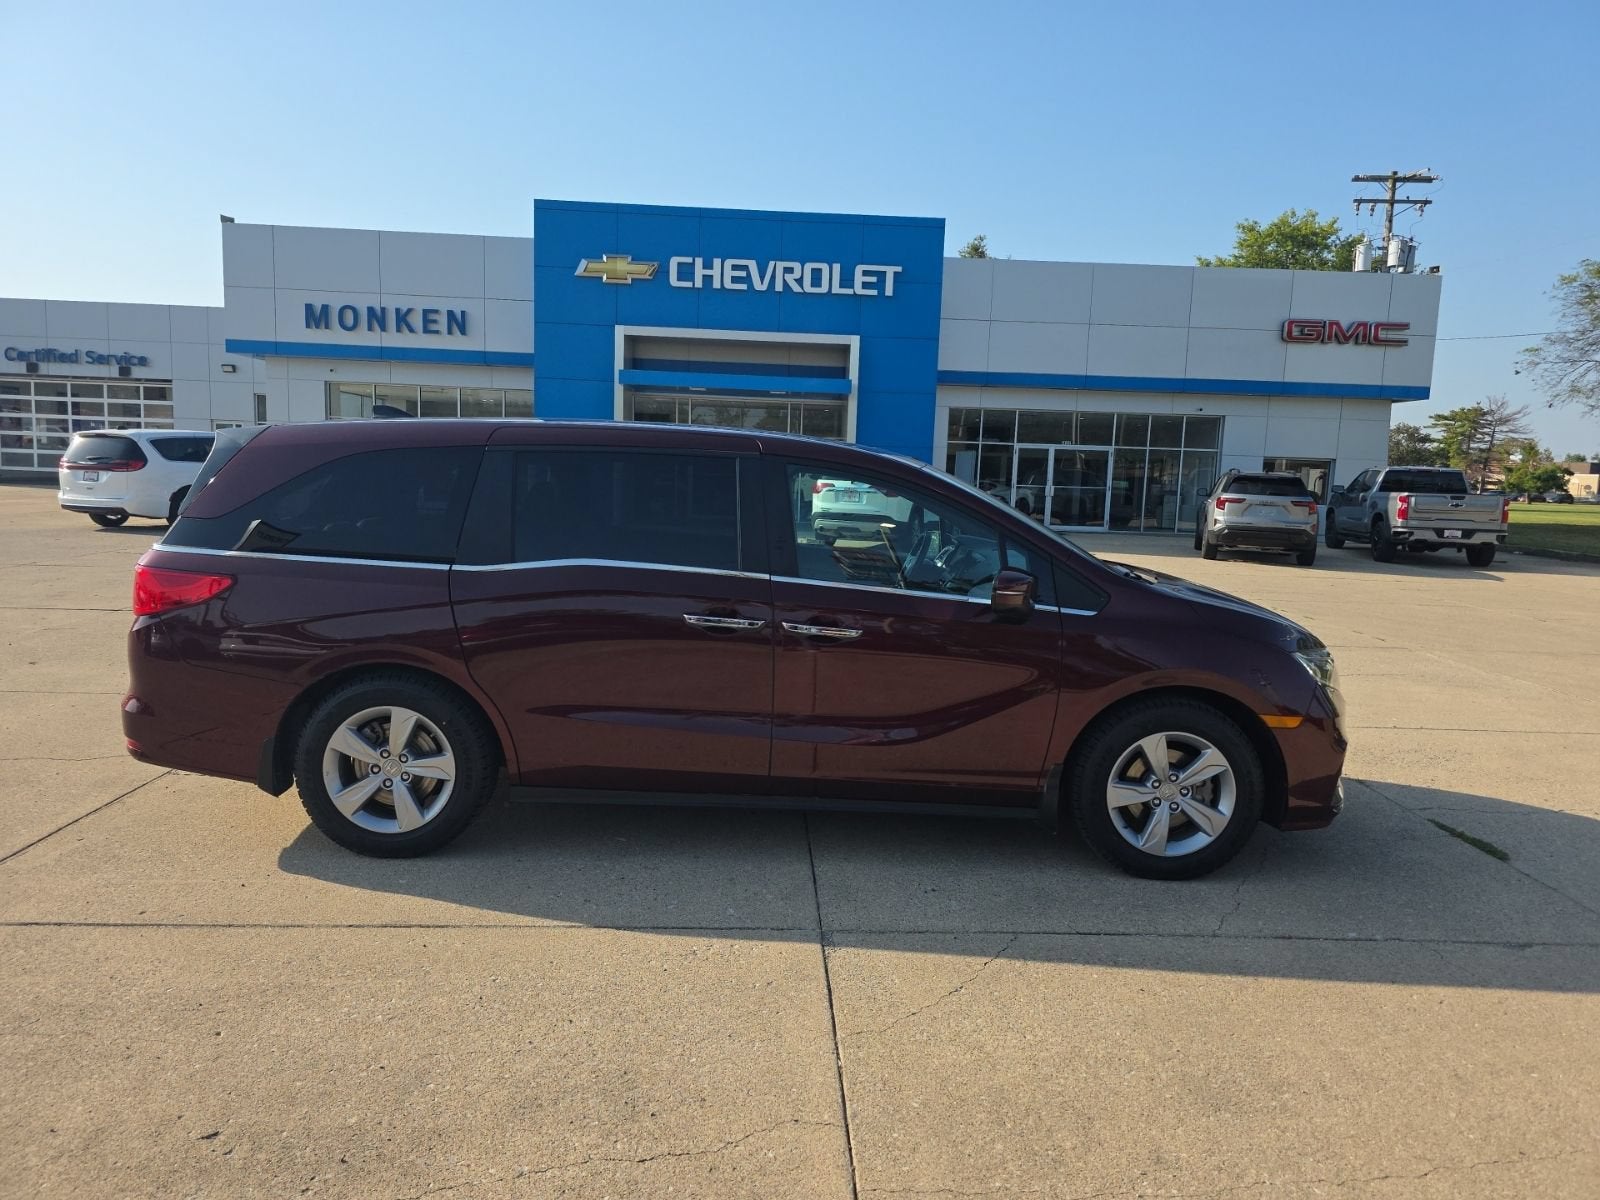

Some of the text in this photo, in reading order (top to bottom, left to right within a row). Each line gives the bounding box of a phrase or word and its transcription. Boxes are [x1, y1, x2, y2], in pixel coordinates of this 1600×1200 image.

[669, 256, 902, 296] CHEVROLET
[304, 303, 468, 336] MONKEN
[1282, 319, 1410, 346] GMC
[4, 347, 149, 366] Certified Service
